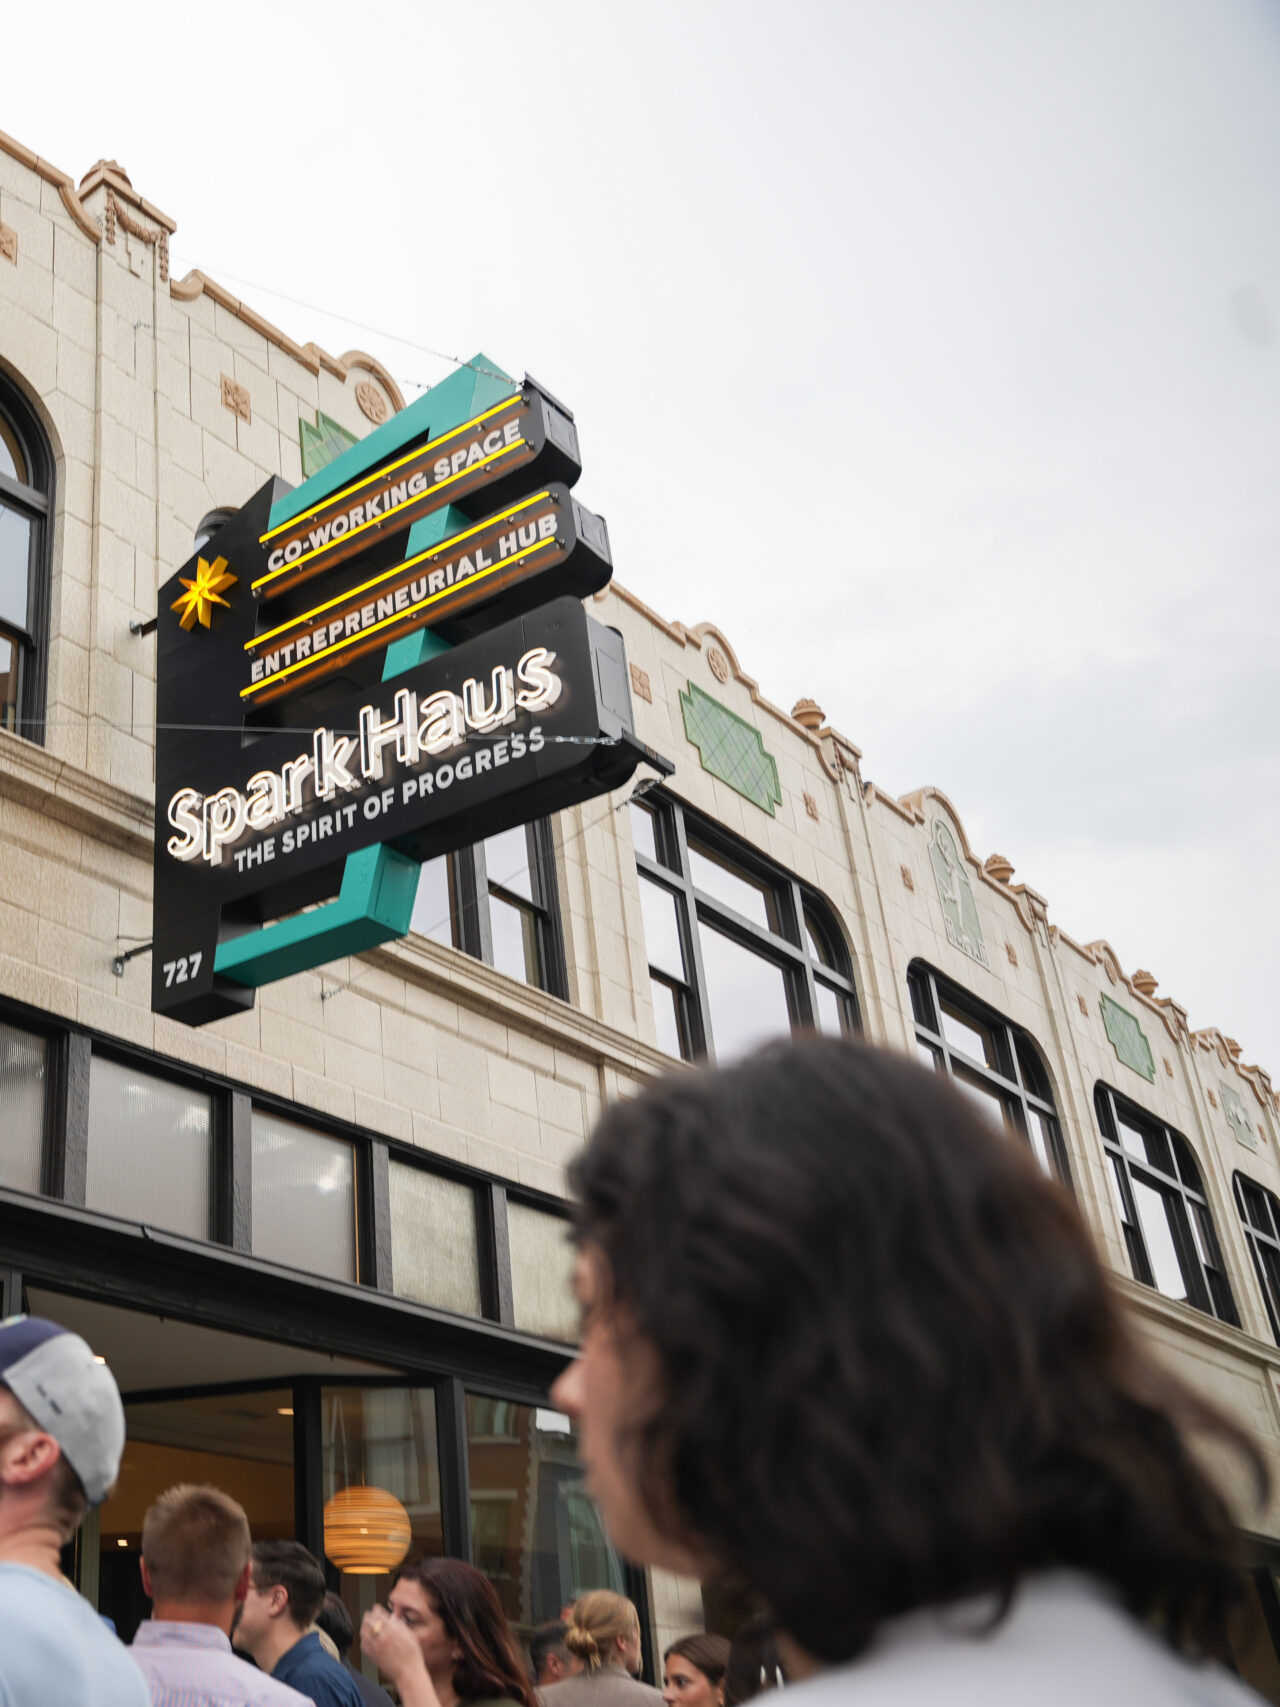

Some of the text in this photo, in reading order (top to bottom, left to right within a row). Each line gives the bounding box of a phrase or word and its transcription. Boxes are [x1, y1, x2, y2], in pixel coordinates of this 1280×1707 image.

[267, 418, 521, 573] CO-WORKING SPACE
[251, 512, 558, 683] ENTREPRENEURIAL HUB
[166, 647, 563, 867] SparkHaus
[234, 726, 545, 873] THE SPIRIT OF PROGRESS
[163, 951, 203, 988] 727
